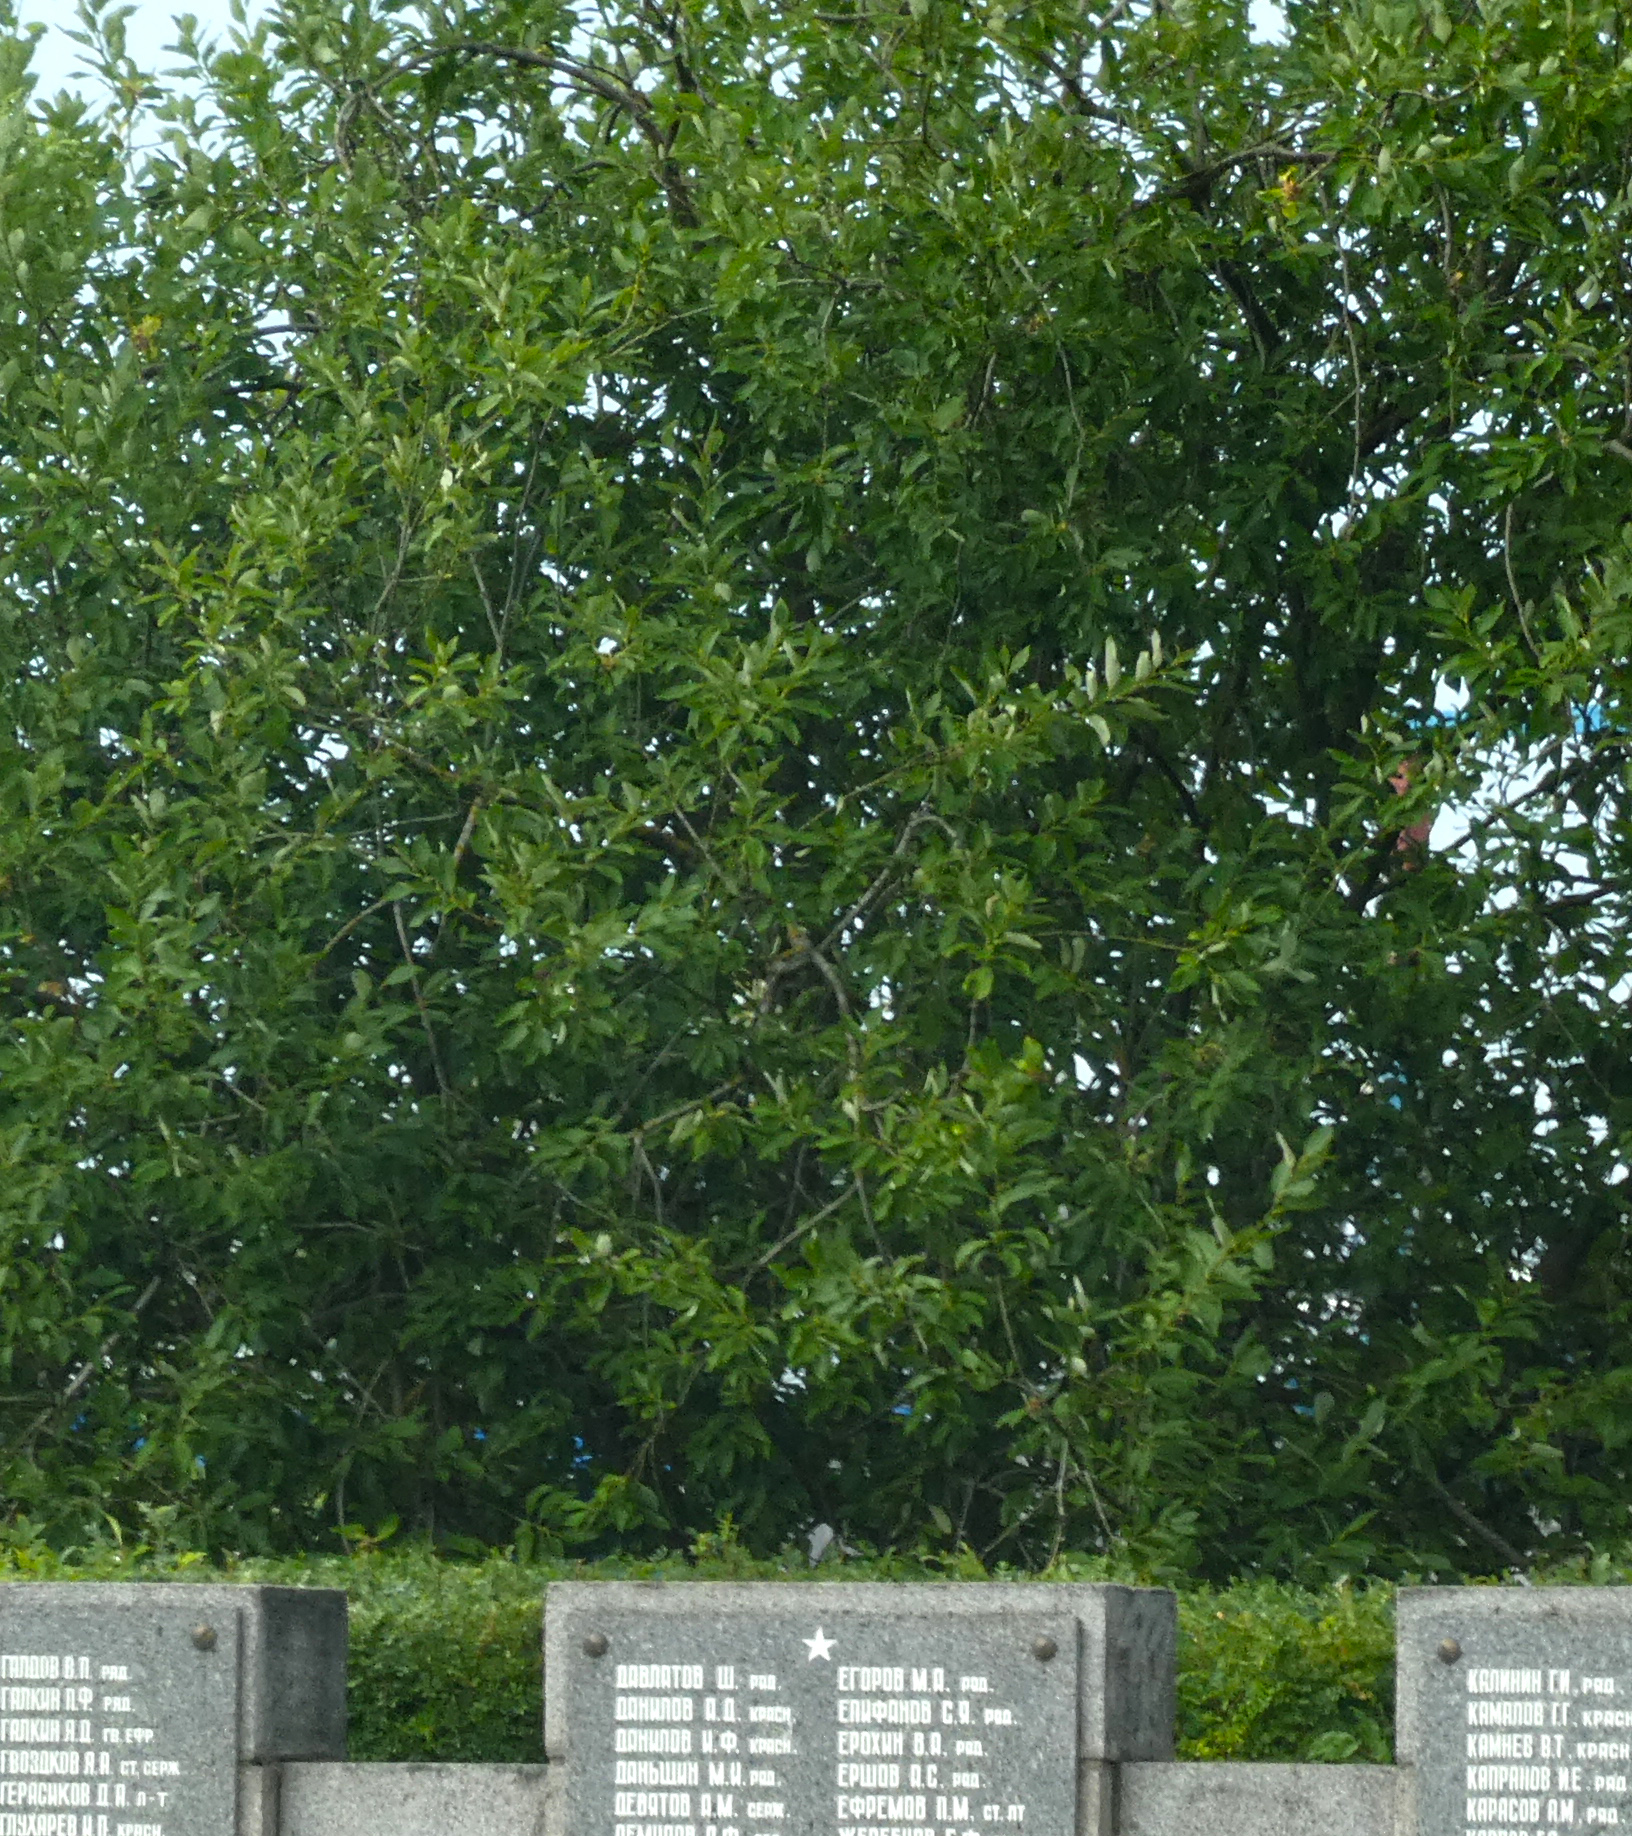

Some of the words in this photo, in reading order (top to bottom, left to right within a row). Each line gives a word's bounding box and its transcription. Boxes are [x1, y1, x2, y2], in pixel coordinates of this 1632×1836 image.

[615, 1663, 704, 1690] ДАВЛАТОВ
[836, 1665, 905, 1692] ЕГОРОВ
[0, 1686, 61, 1711] ГАЛКИН
[614, 1727, 692, 1753] ДАНИЛОВ
[836, 1730, 904, 1755] ЕРОХИН
[1466, 1732, 1534, 1758] КАМНЕВ
[0, 1749, 80, 1776] ГВОЗДКОВ
[836, 1762, 901, 1788] ЕРШОВ
[614, 1791, 691, 1817] ДЕВЯТОВ
[836, 1794, 927, 1820] ЕФРЕМОВ
[1466, 1796, 1540, 1823] КАРАСОВ
